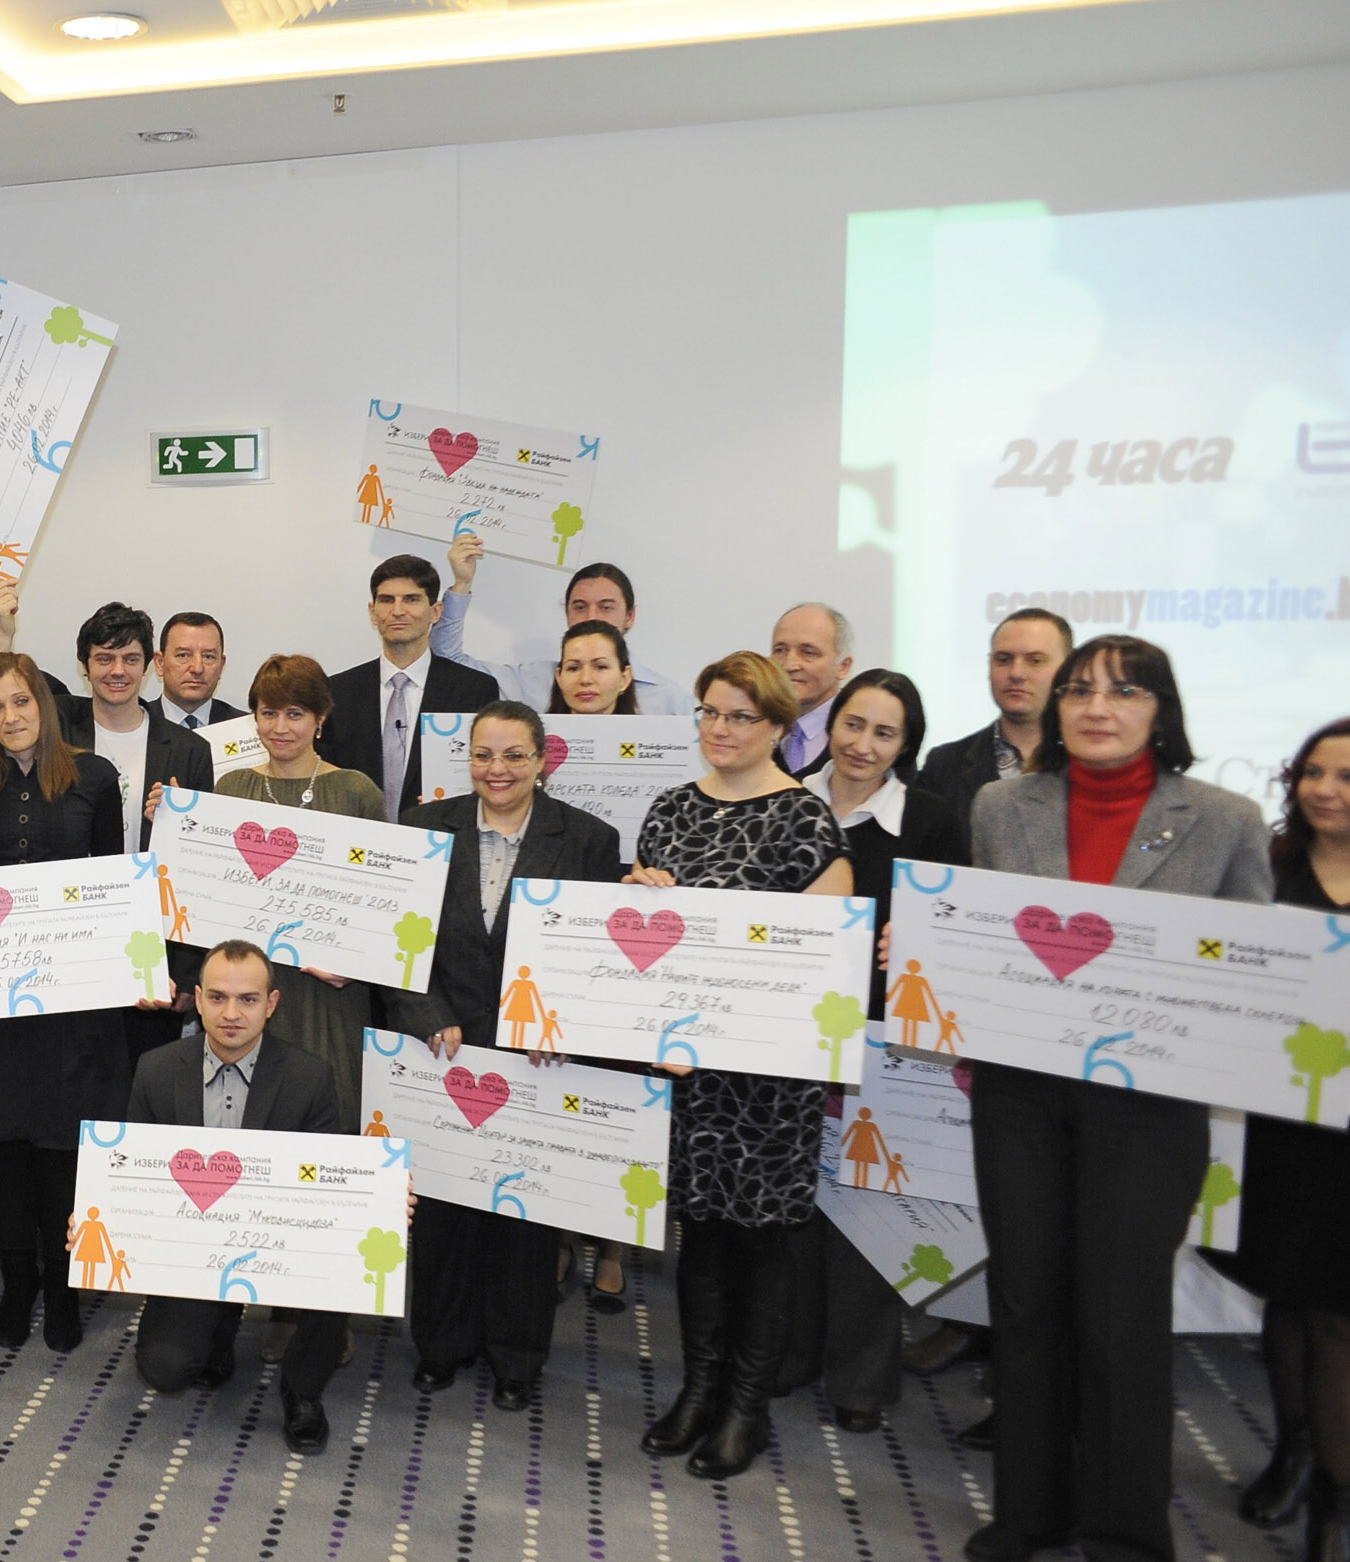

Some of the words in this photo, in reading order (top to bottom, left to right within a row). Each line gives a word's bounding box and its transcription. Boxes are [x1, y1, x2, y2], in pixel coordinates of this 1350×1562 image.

[993, 437, 1078, 497] 24
[1086, 436, 1235, 486] часа
[545, 744, 594, 754] ОМОГНЕШ
[637, 742, 688, 751] Райфайзен
[637, 751, 664, 759] БАНК
[239, 831, 252, 841] ЗА
[253, 833, 268, 844] ДА
[269, 836, 324, 854] ПОМОГНЕШ
[367, 849, 417, 864] Райфайзен
[365, 858, 392, 870] БАНК
[80, 882, 130, 892] Райфайзен
[82, 891, 107, 901] БАНК
[176, 1159, 189, 1170] ЗА
[192, 1161, 208, 1172] ДА
[210, 1162, 271, 1176] ПОМОГНЕШ
[319, 1164, 375, 1176] Райфайзен
[318, 1174, 347, 1184] БАНК
